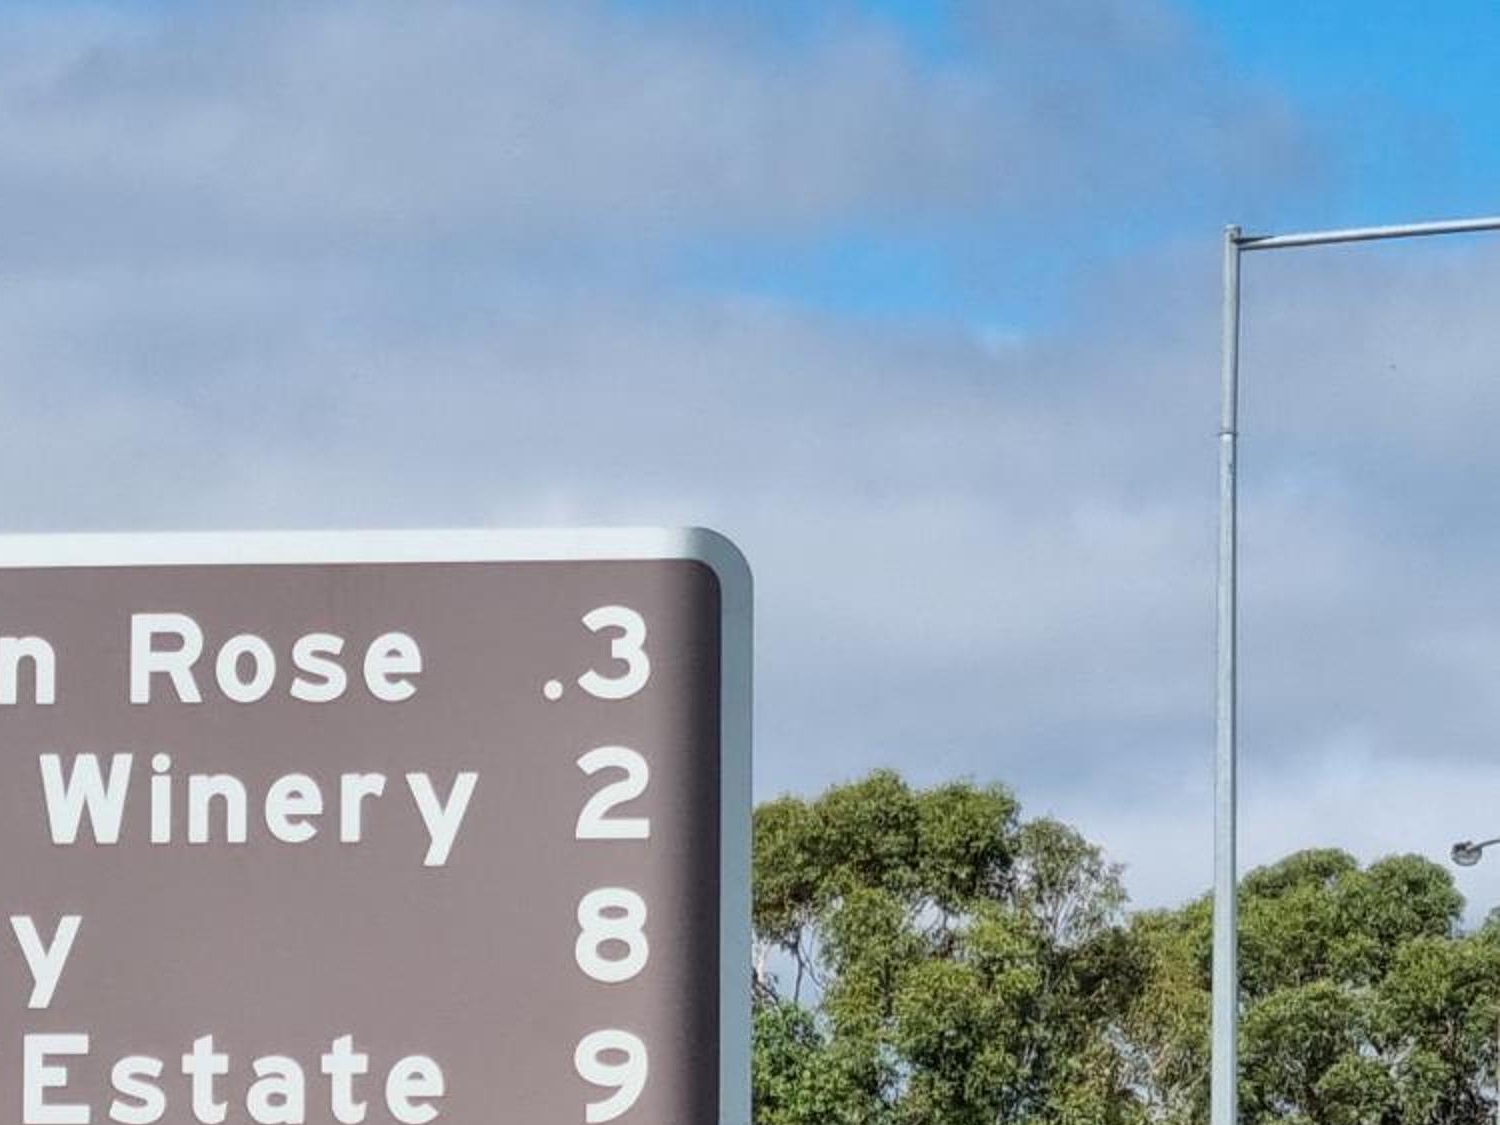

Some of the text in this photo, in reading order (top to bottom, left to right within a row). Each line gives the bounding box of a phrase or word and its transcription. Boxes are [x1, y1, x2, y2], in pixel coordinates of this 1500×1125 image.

[130, 613, 422, 704] Rose
[543, 605, 651, 700] .3
[39, 753, 479, 867] Winery
[575, 745, 650, 840] 2
[575, 887, 650, 983] 8
[23, 1033, 445, 1125] Estate
[574, 1028, 649, 1125] 9
